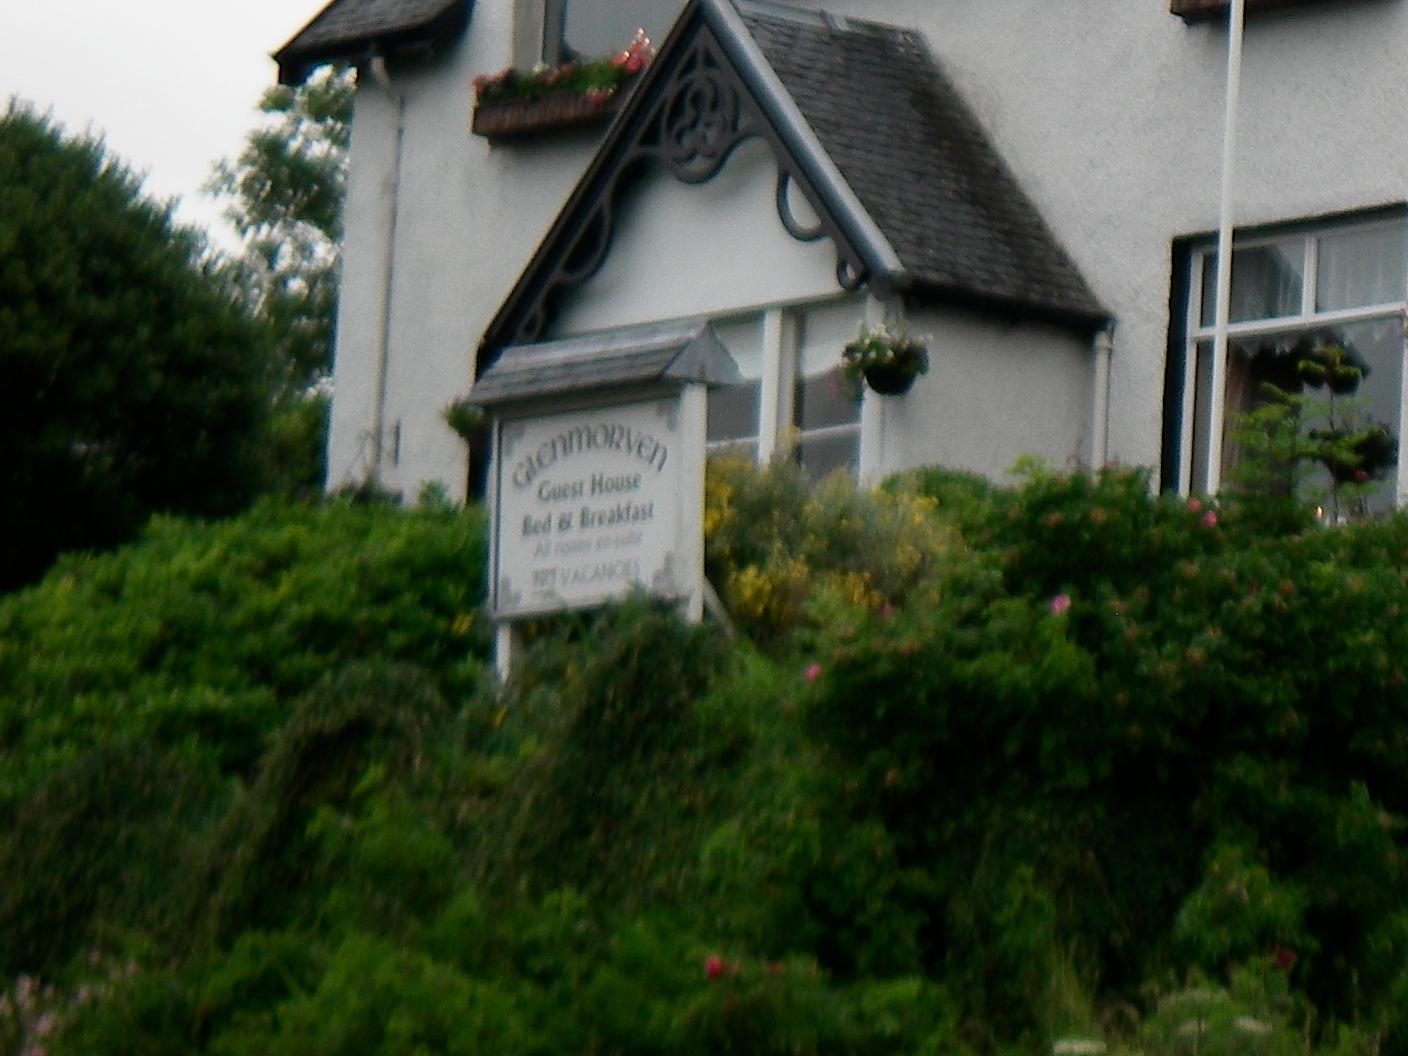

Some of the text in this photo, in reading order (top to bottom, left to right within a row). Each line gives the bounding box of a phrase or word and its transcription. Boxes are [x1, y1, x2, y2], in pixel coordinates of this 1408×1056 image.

[538, 473, 641, 501] Guest House
[523, 502, 653, 536] Bed & Breakfast
